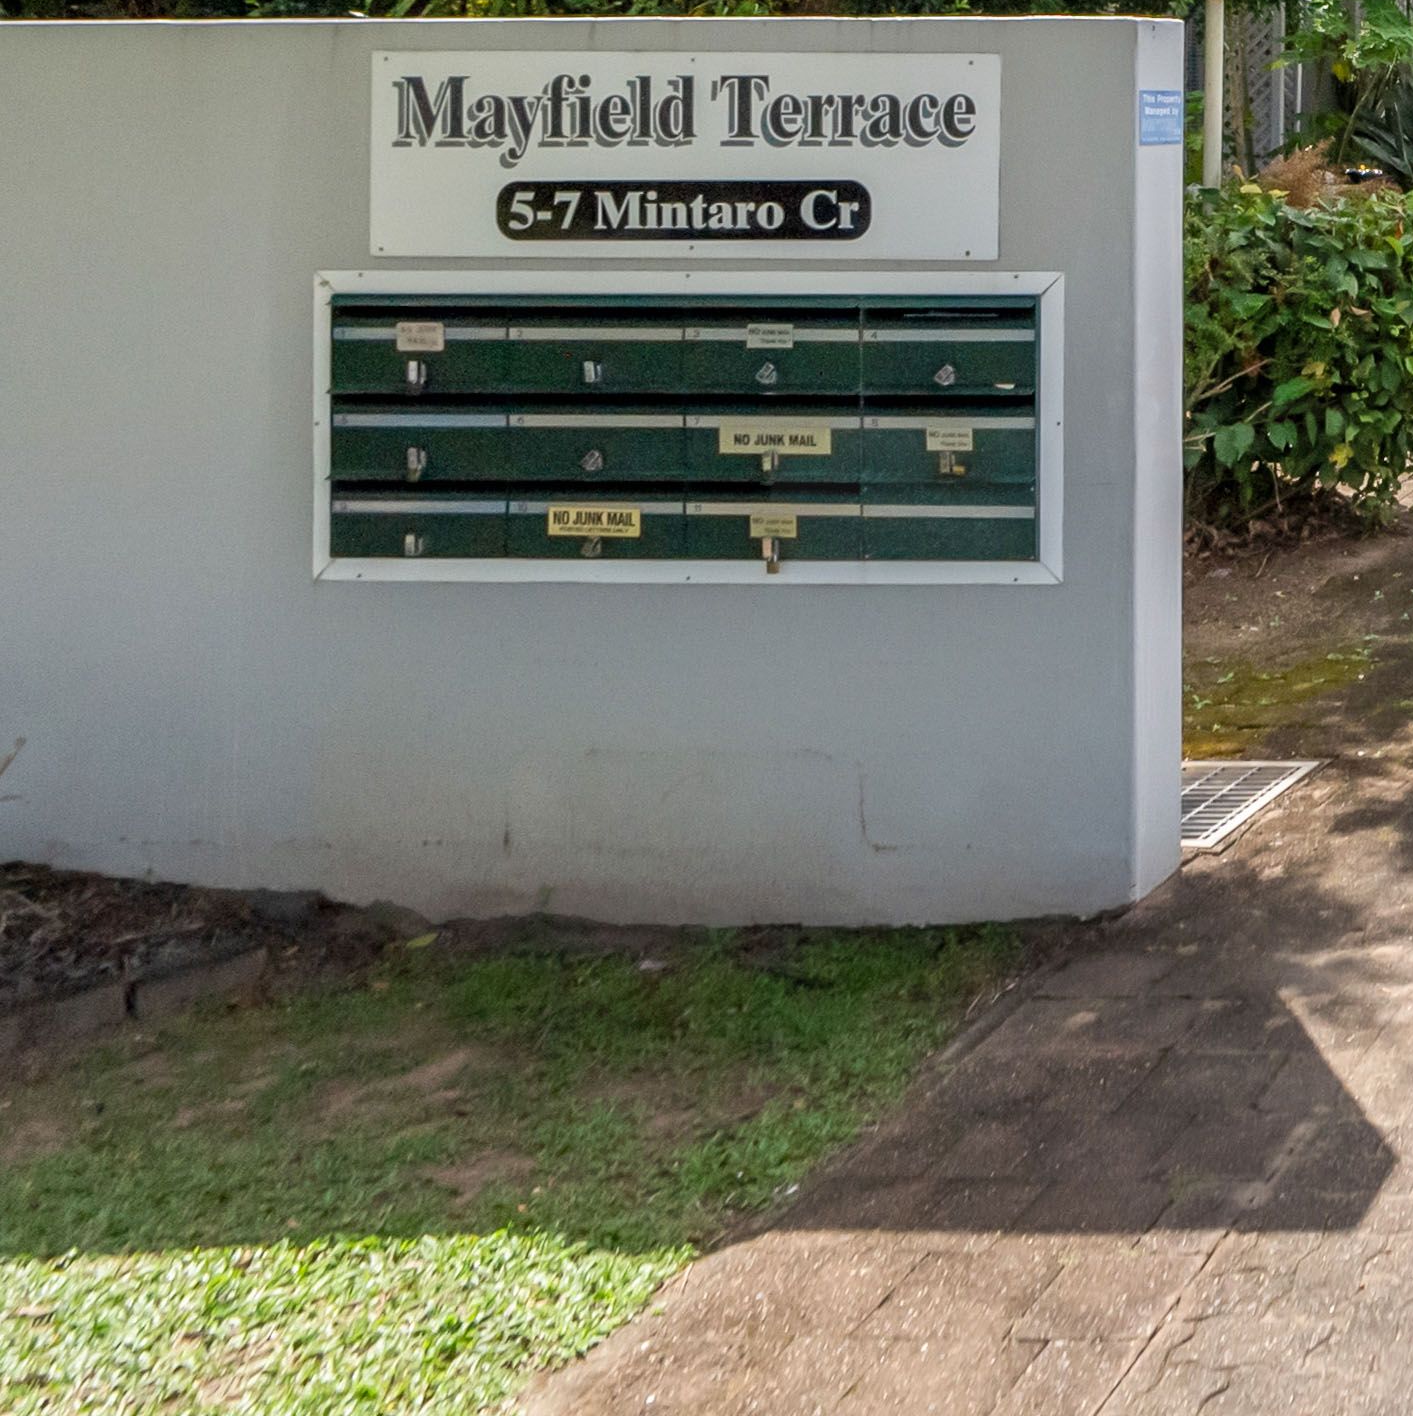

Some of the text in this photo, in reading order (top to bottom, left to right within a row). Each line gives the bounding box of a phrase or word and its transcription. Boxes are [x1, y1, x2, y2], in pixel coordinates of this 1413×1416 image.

[392, 73, 977, 169] Mayfield Terrace
[508, 189, 860, 231] 5-7 Mintaro Cr
[734, 434, 817, 446] NO JUNK MAIL
[553, 510, 635, 527] NO JUNK MAIL
